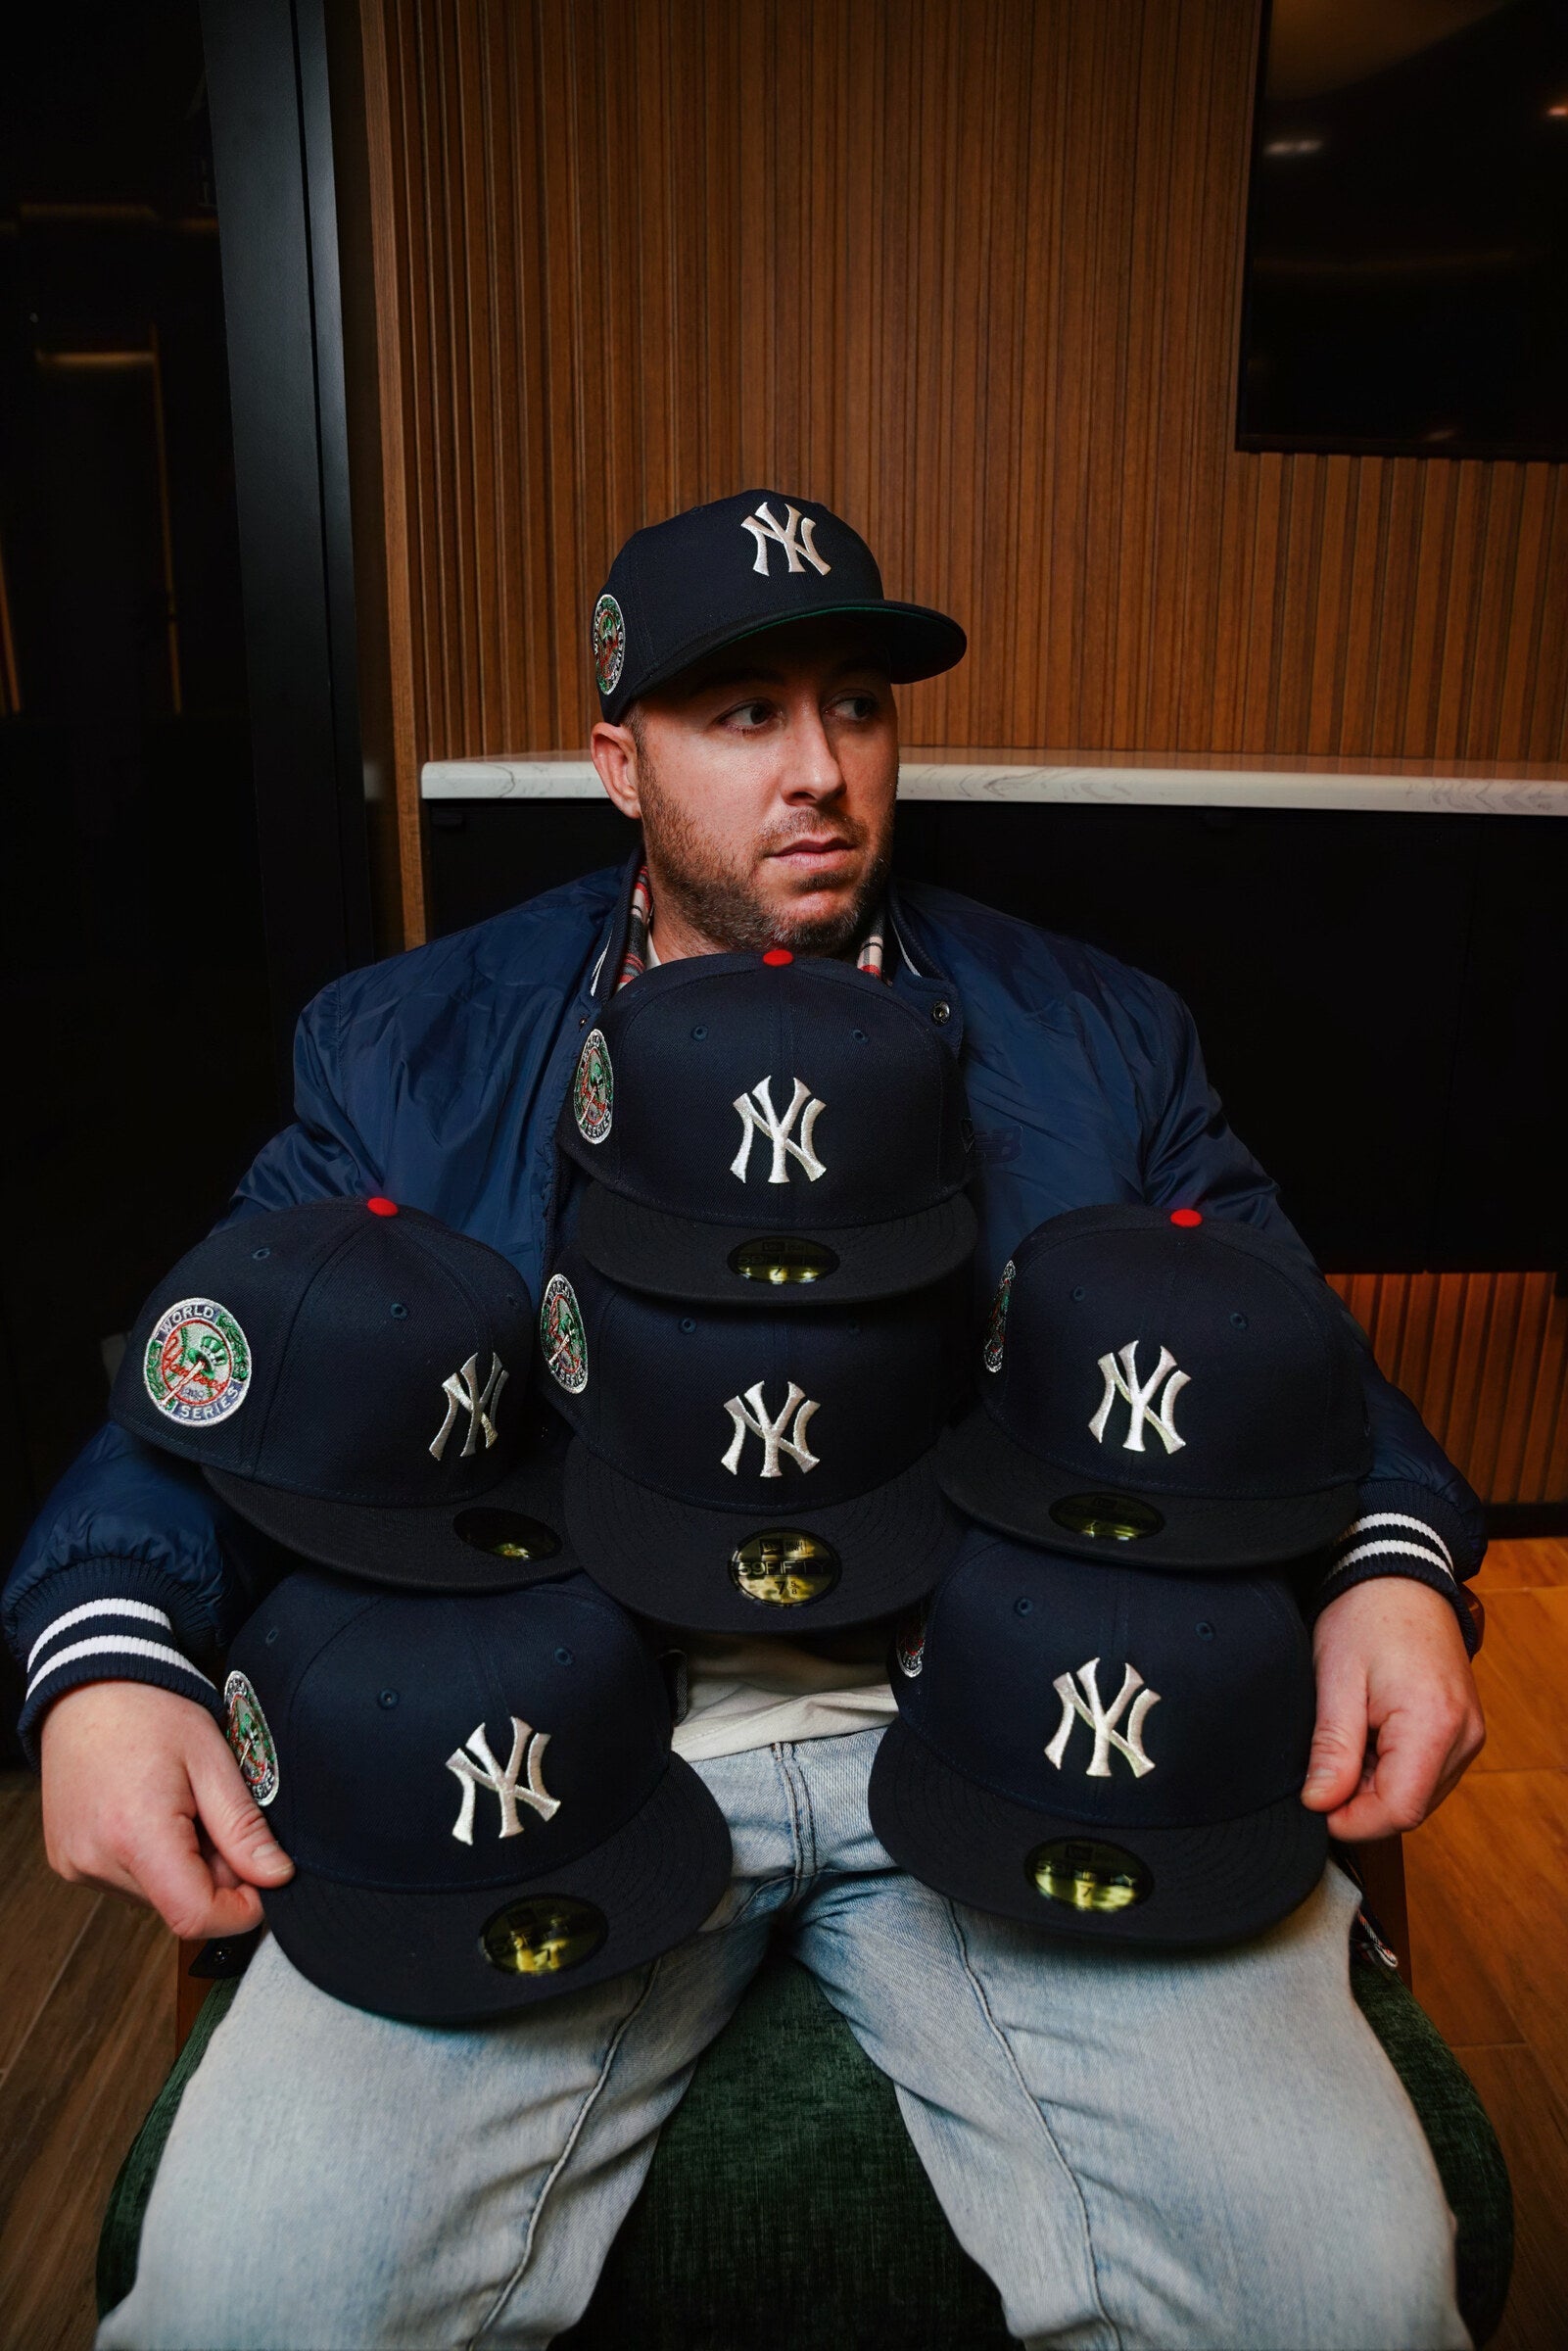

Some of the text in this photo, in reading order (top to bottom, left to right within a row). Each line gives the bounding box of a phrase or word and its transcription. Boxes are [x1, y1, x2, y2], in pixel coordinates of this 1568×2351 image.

[741, 502, 831, 576] NY
[730, 1076, 827, 1183] NY
[160, 1305, 215, 1334] WORLD
[180, 1386, 240, 1419] SERIES
[428, 1352, 510, 1461] NY
[721, 1380, 821, 1477] NY
[1089, 1340, 1191, 1454] NY
[1045, 1657, 1162, 1778] NY
[446, 1716, 561, 1846] NY
